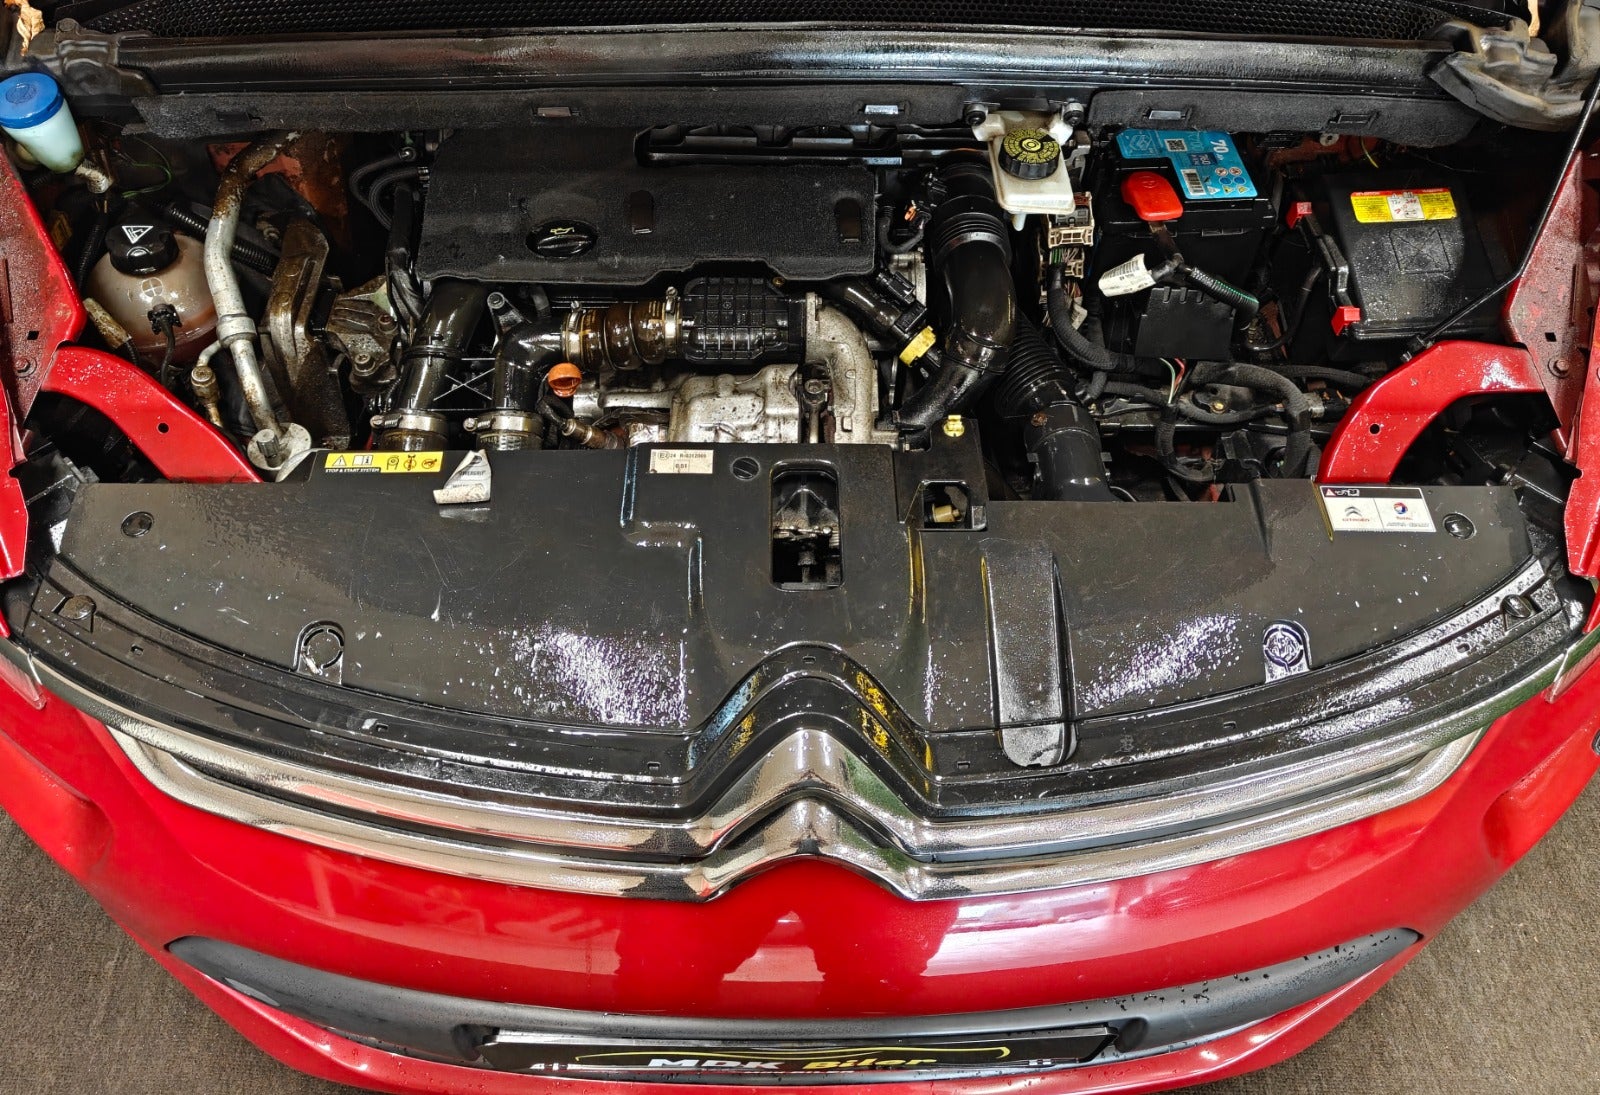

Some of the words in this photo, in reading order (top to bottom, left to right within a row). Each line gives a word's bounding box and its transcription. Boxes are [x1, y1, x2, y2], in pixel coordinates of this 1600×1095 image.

[1210, 139, 1229, 154] 70
[648, 1058, 786, 1070] MDK
[802, 1058, 938, 1070] Biler
